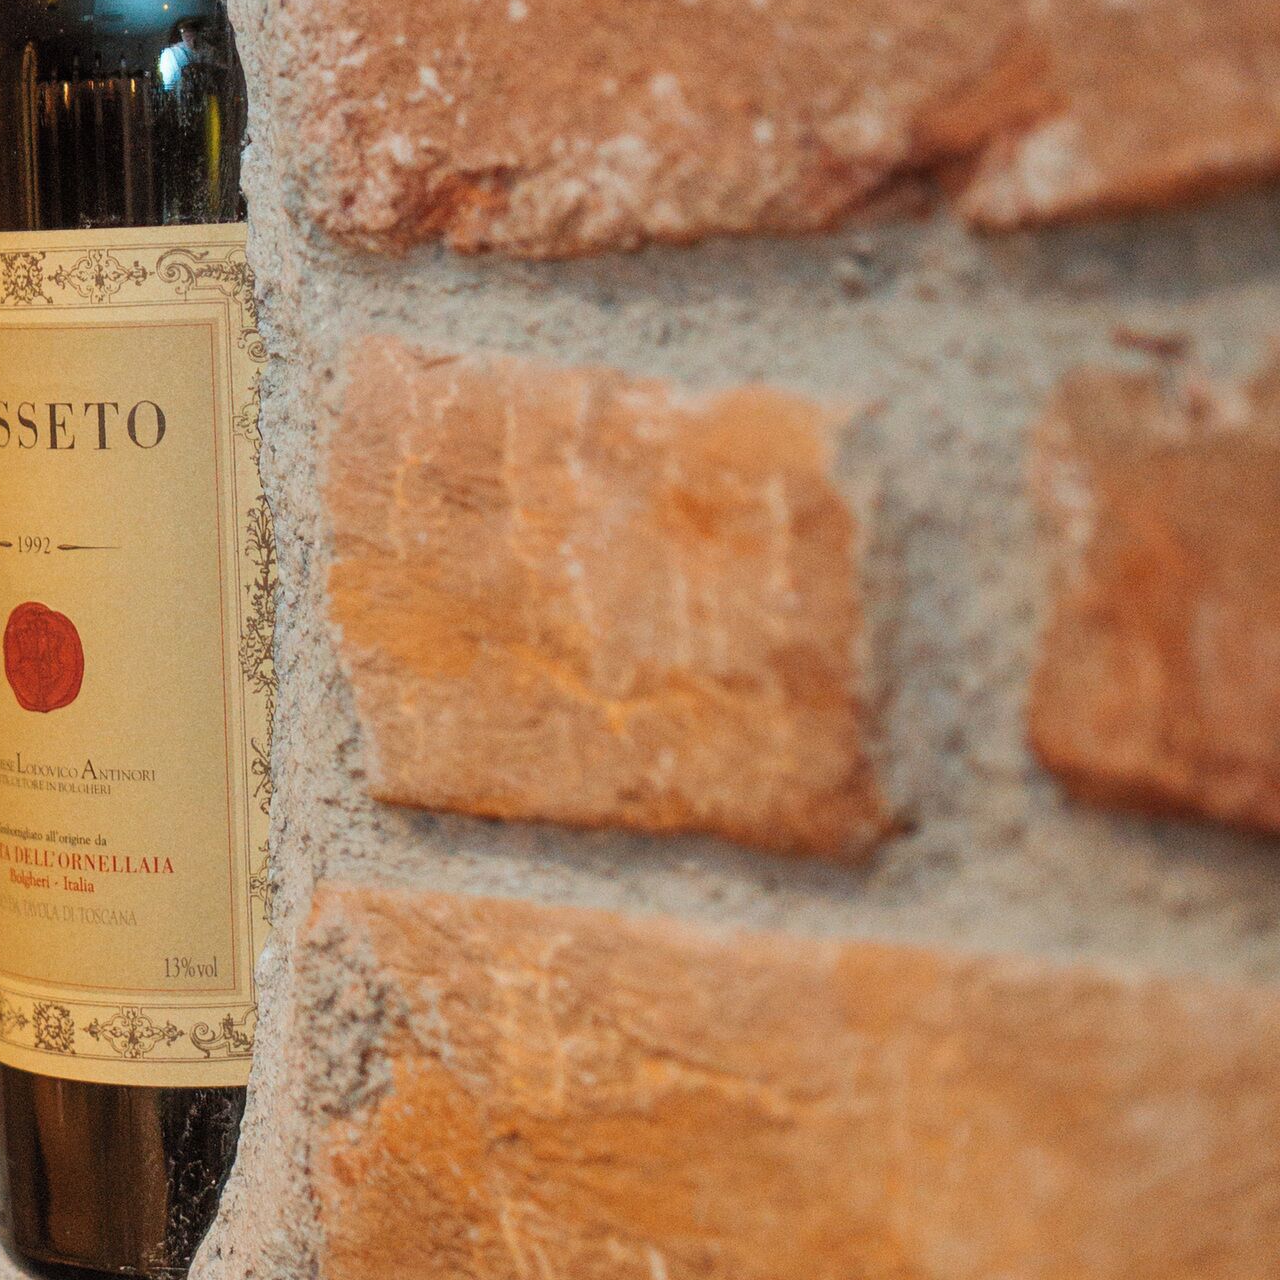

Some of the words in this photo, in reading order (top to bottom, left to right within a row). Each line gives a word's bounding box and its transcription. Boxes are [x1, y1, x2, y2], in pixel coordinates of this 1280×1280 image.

[17, 536, 51, 554] 1992
[81, 758, 156, 782] ANTINORI
[94, 833, 107, 846] da
[9, 867, 50, 889] Bolgheri
[63, 876, 95, 893] Italia
